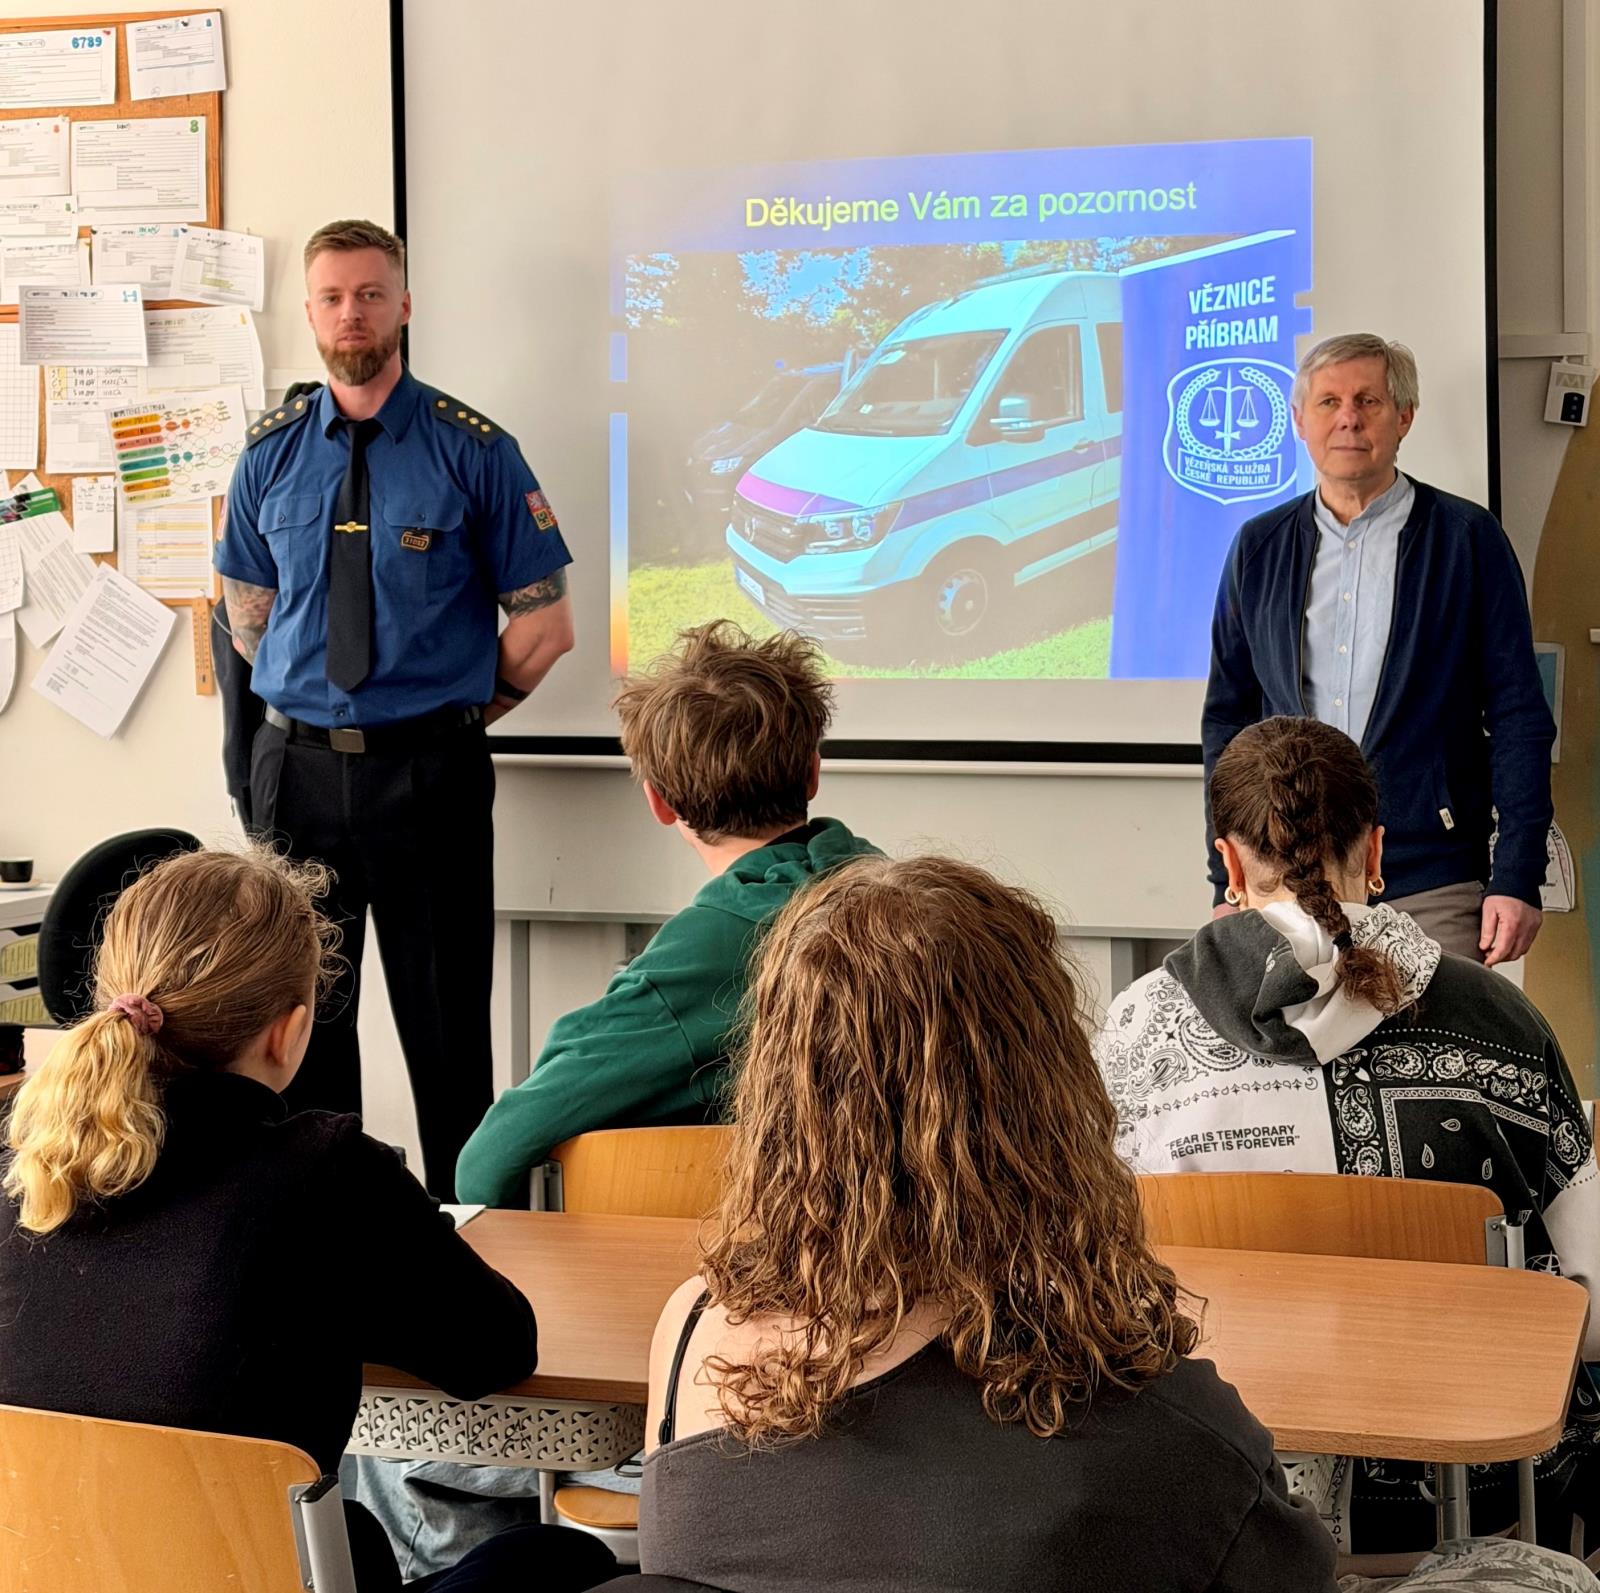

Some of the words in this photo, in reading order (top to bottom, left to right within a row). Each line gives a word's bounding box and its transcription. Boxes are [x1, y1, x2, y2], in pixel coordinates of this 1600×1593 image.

[72, 36, 102, 49] 6789
[745, 195, 899, 232] Děkujeme
[908, 190, 980, 221] Vám
[990, 194, 1028, 218] za
[1039, 181, 1198, 223] pozornost
[1188, 275, 1276, 314] VĚZNICE
[1185, 315, 1279, 350] PŘÍBRAM
[1184, 466, 1211, 483] ČESKÉ
[1216, 474, 1270, 485] REPUBLIKY
[1233, 463, 1271, 475] SLUŽBA
[1202, 1131, 1215, 1142] IS
[1216, 1125, 1295, 1141] TEMPORARY
[1171, 1142, 1219, 1160] REGRET
[1222, 1140, 1235, 1151] IS
